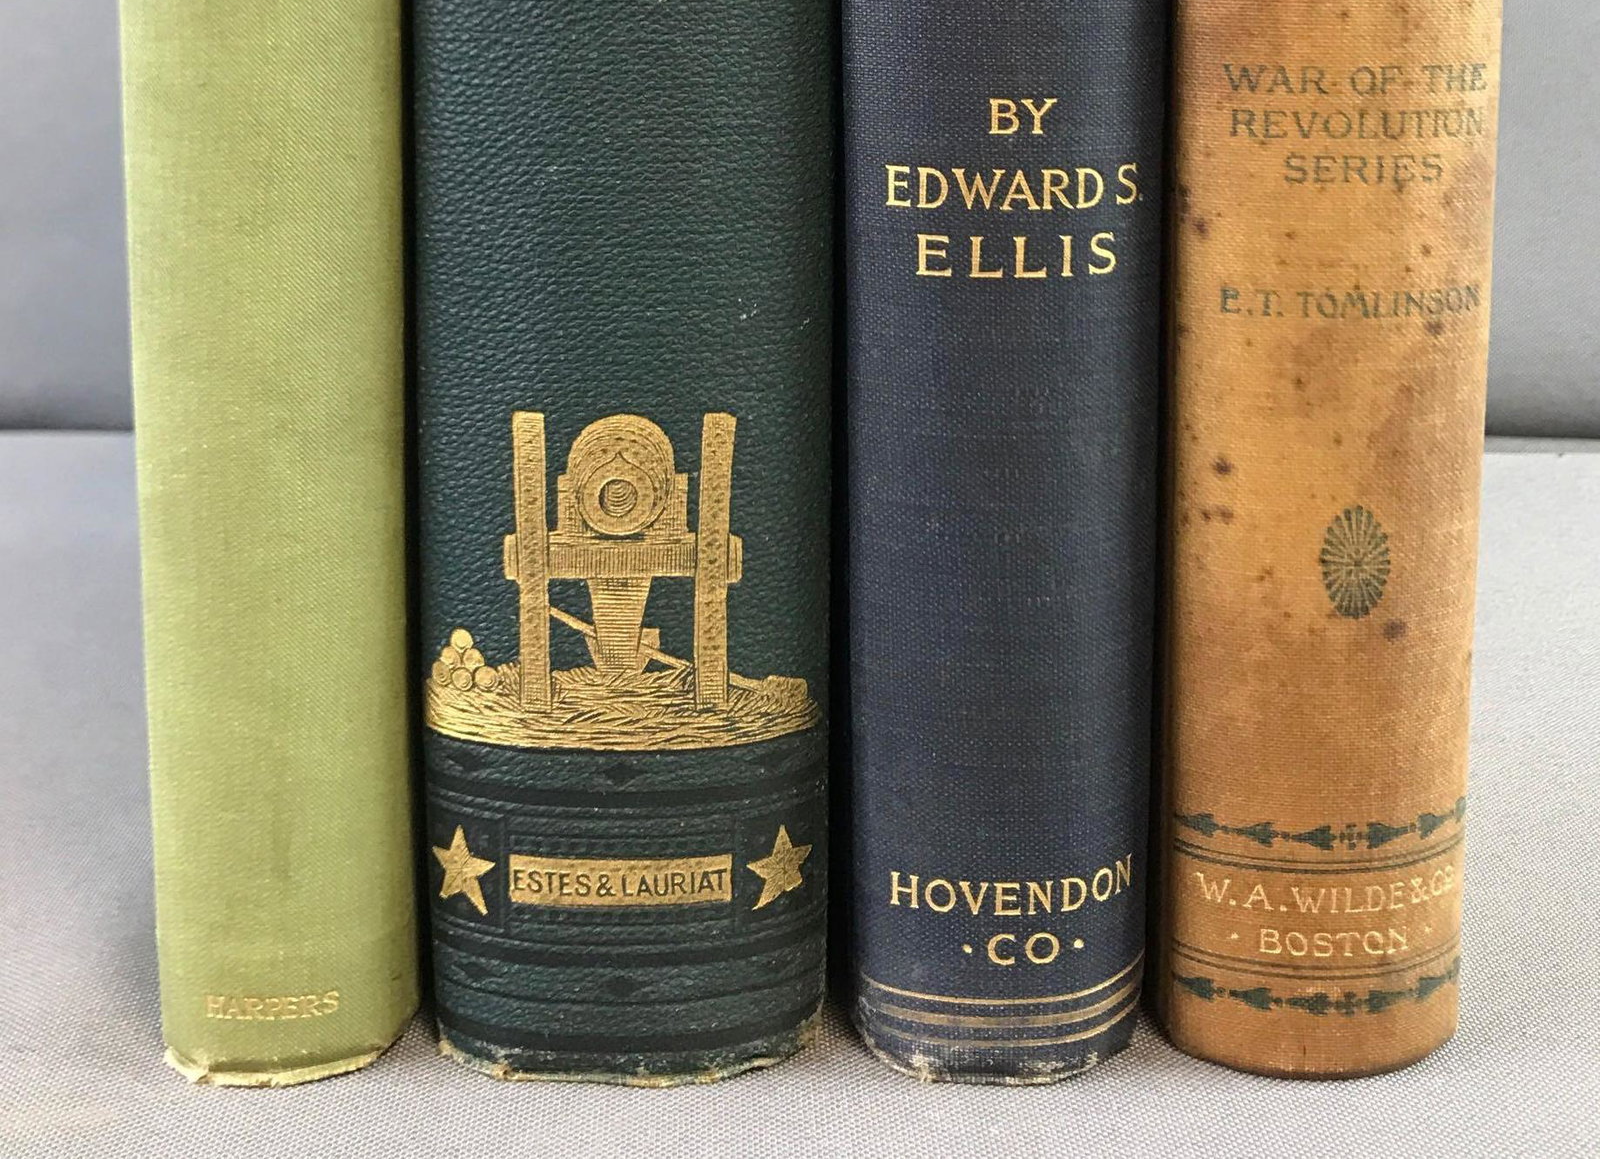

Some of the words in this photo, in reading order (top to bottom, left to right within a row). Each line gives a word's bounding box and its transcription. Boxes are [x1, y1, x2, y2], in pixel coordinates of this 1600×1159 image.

[1422, 62, 1488, 93] THE
[988, 97, 1058, 135] BY
[1229, 107, 1484, 140] REVOLUTION
[1283, 152, 1443, 185] SERIES
[885, 163, 1105, 211] EDWARD
[915, 231, 1118, 279] ELLIS
[1297, 283, 1480, 320] TOMLINSON
[513, 868, 592, 898] ESTES
[595, 872, 614, 898] &
[621, 867, 729, 899] LAURIAT
[890, 853, 1133, 916] HOVENDON
[1259, 926, 1409, 957] BOSTON
[205, 990, 340, 1021] HARPERS
